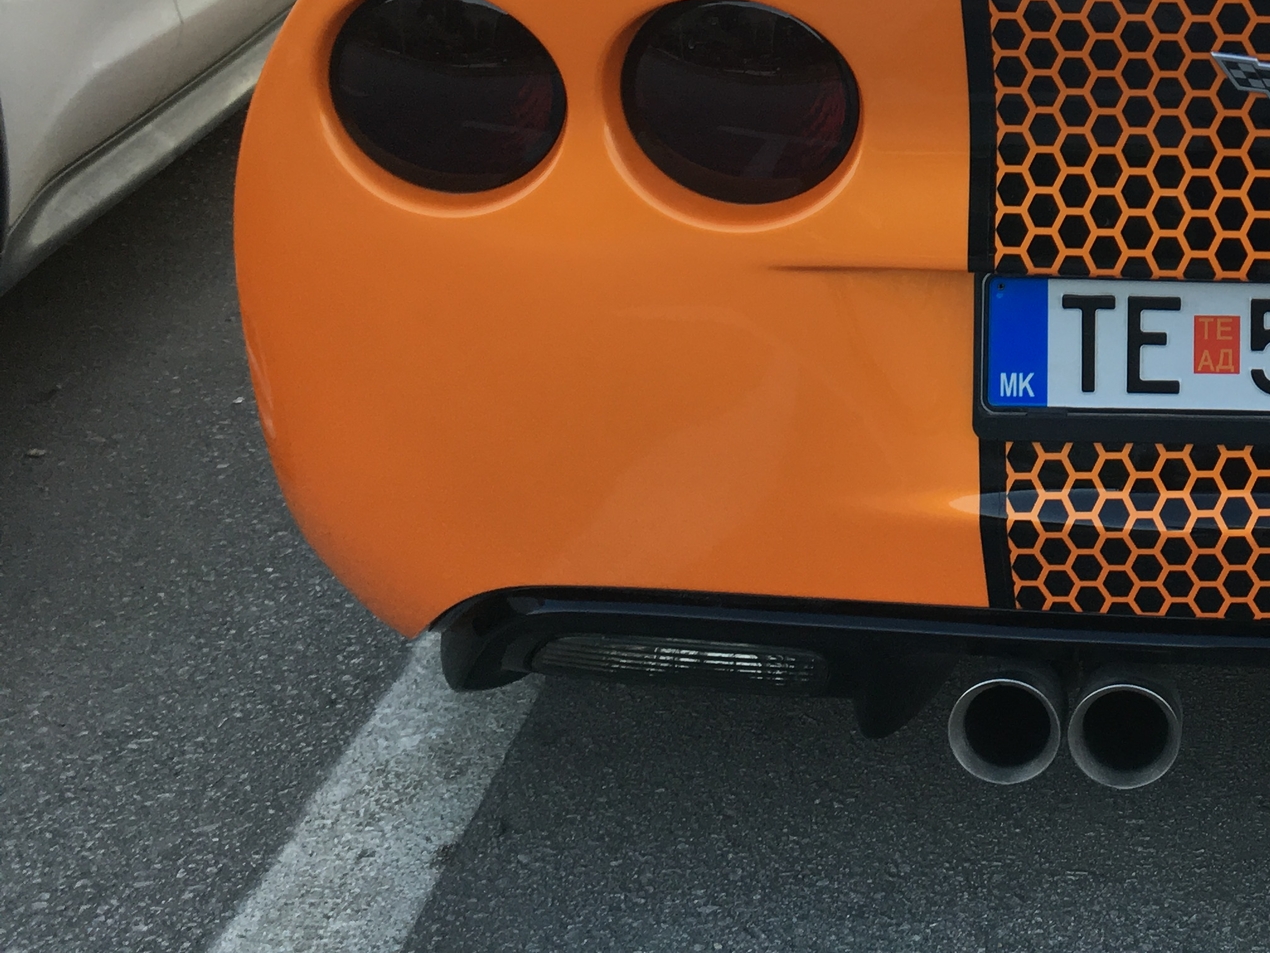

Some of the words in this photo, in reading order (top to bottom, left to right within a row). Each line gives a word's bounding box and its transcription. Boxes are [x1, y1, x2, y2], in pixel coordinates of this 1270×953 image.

[1062, 294, 1182, 394] TE
[1196, 348, 1236, 373] АД
[999, 372, 1035, 398] MK
